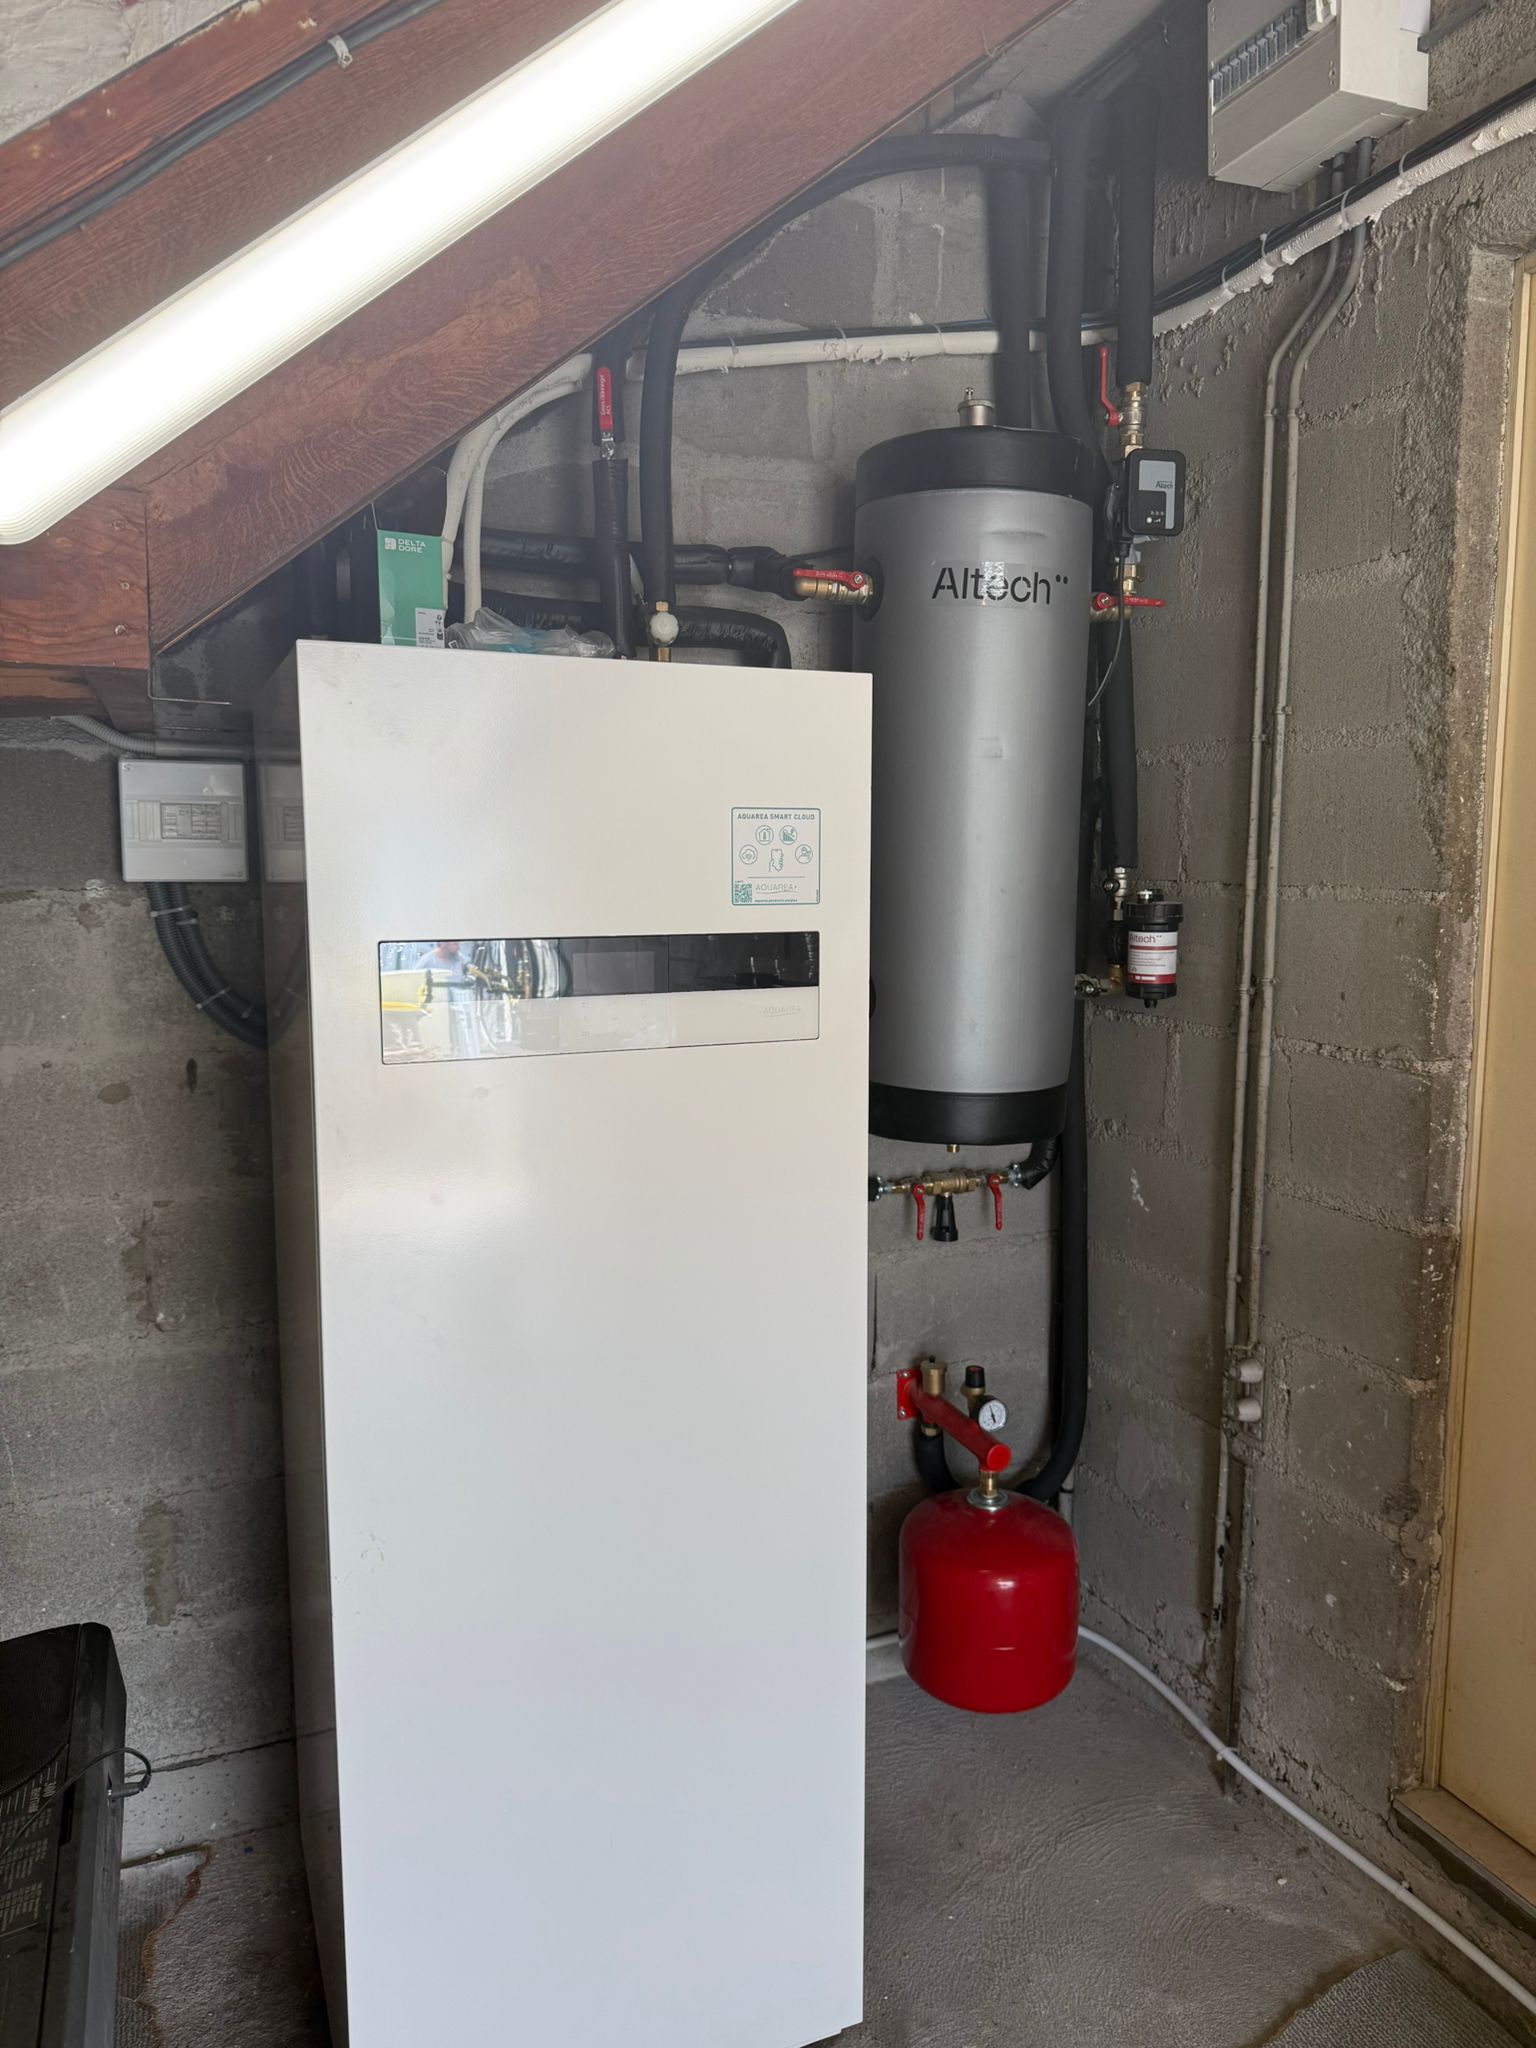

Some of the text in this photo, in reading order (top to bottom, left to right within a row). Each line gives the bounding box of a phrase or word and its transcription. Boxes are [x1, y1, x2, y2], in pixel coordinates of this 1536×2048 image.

[398, 538, 426, 548] DELTA
[398, 545, 424, 554] DORE
[931, 567, 1051, 605] Altech
